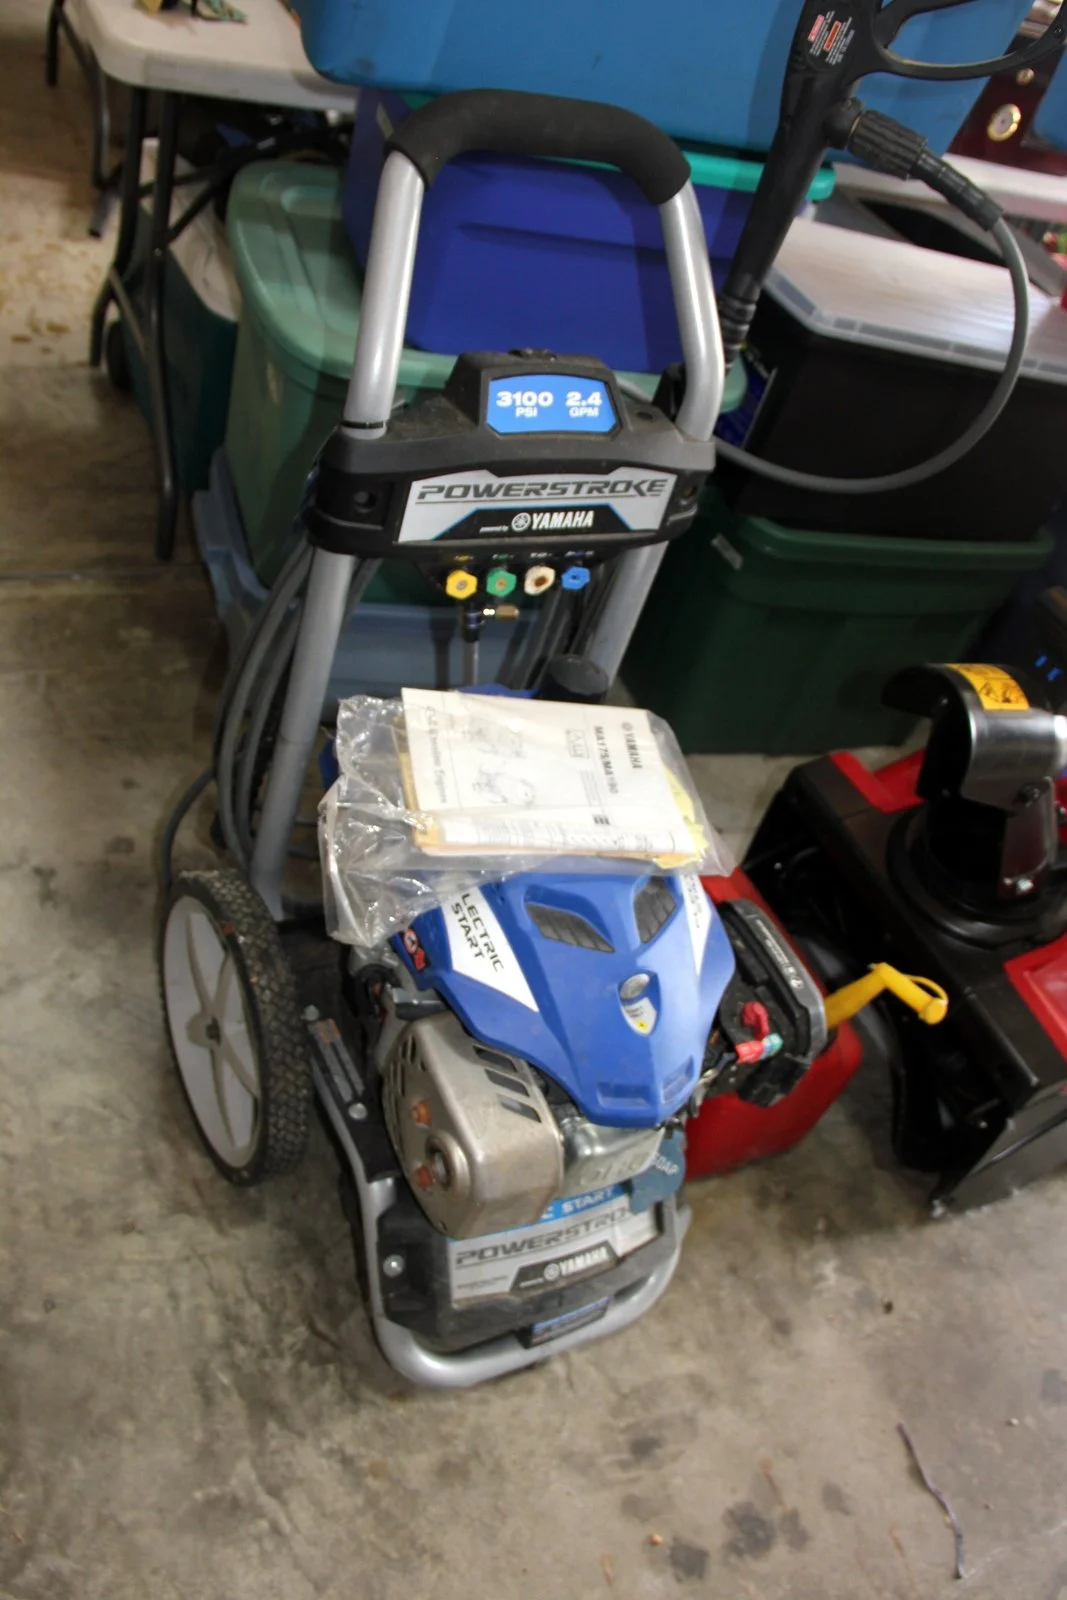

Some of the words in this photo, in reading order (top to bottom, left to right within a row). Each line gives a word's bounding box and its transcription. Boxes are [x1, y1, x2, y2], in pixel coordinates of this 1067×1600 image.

[496, 391, 553, 407] 3100
[565, 391, 602, 406] 2.4
[515, 406, 537, 418] PSI
[569, 406, 599, 418] GPM
[418, 479, 668, 500] POWERSTROKE
[532, 510, 594, 530] YAMAHA
[624, 731, 643, 769] YAMAHA
[451, 902, 485, 958] START
[460, 887, 504, 973] LECTRIC
[561, 1187, 613, 1213] START
[455, 1205, 629, 1265] POWERSTRO
[559, 1246, 609, 1277] YAMAHA
